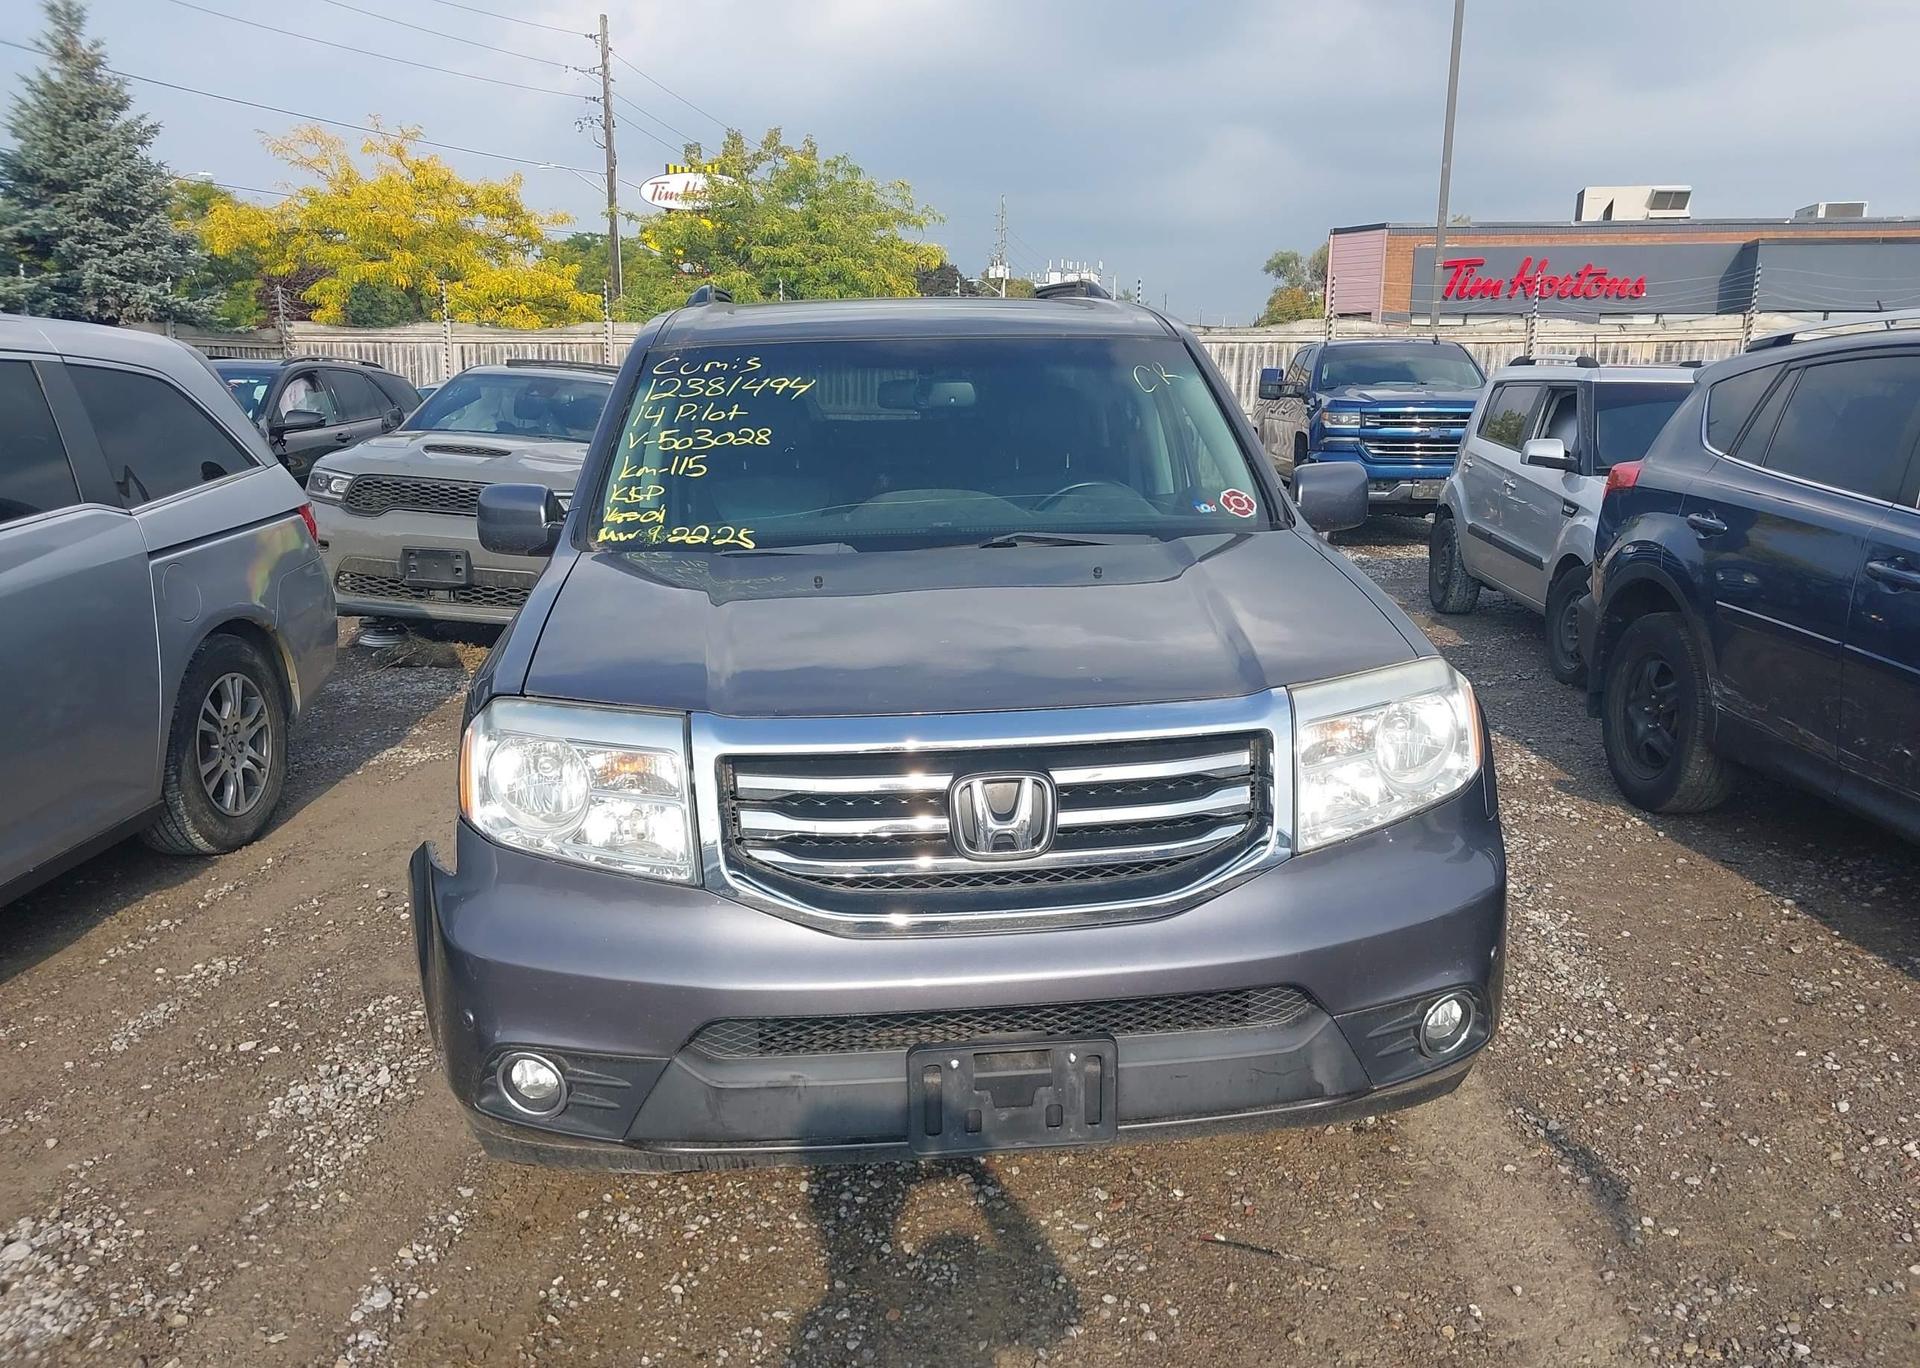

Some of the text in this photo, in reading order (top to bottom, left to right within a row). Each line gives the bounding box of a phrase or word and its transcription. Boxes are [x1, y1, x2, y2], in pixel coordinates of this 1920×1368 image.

[649, 181, 679, 202] Tim
[1441, 255, 1647, 300] Tim Hortons
[643, 376, 816, 402] 12381494
[633, 403, 749, 427] 14 Pilot
